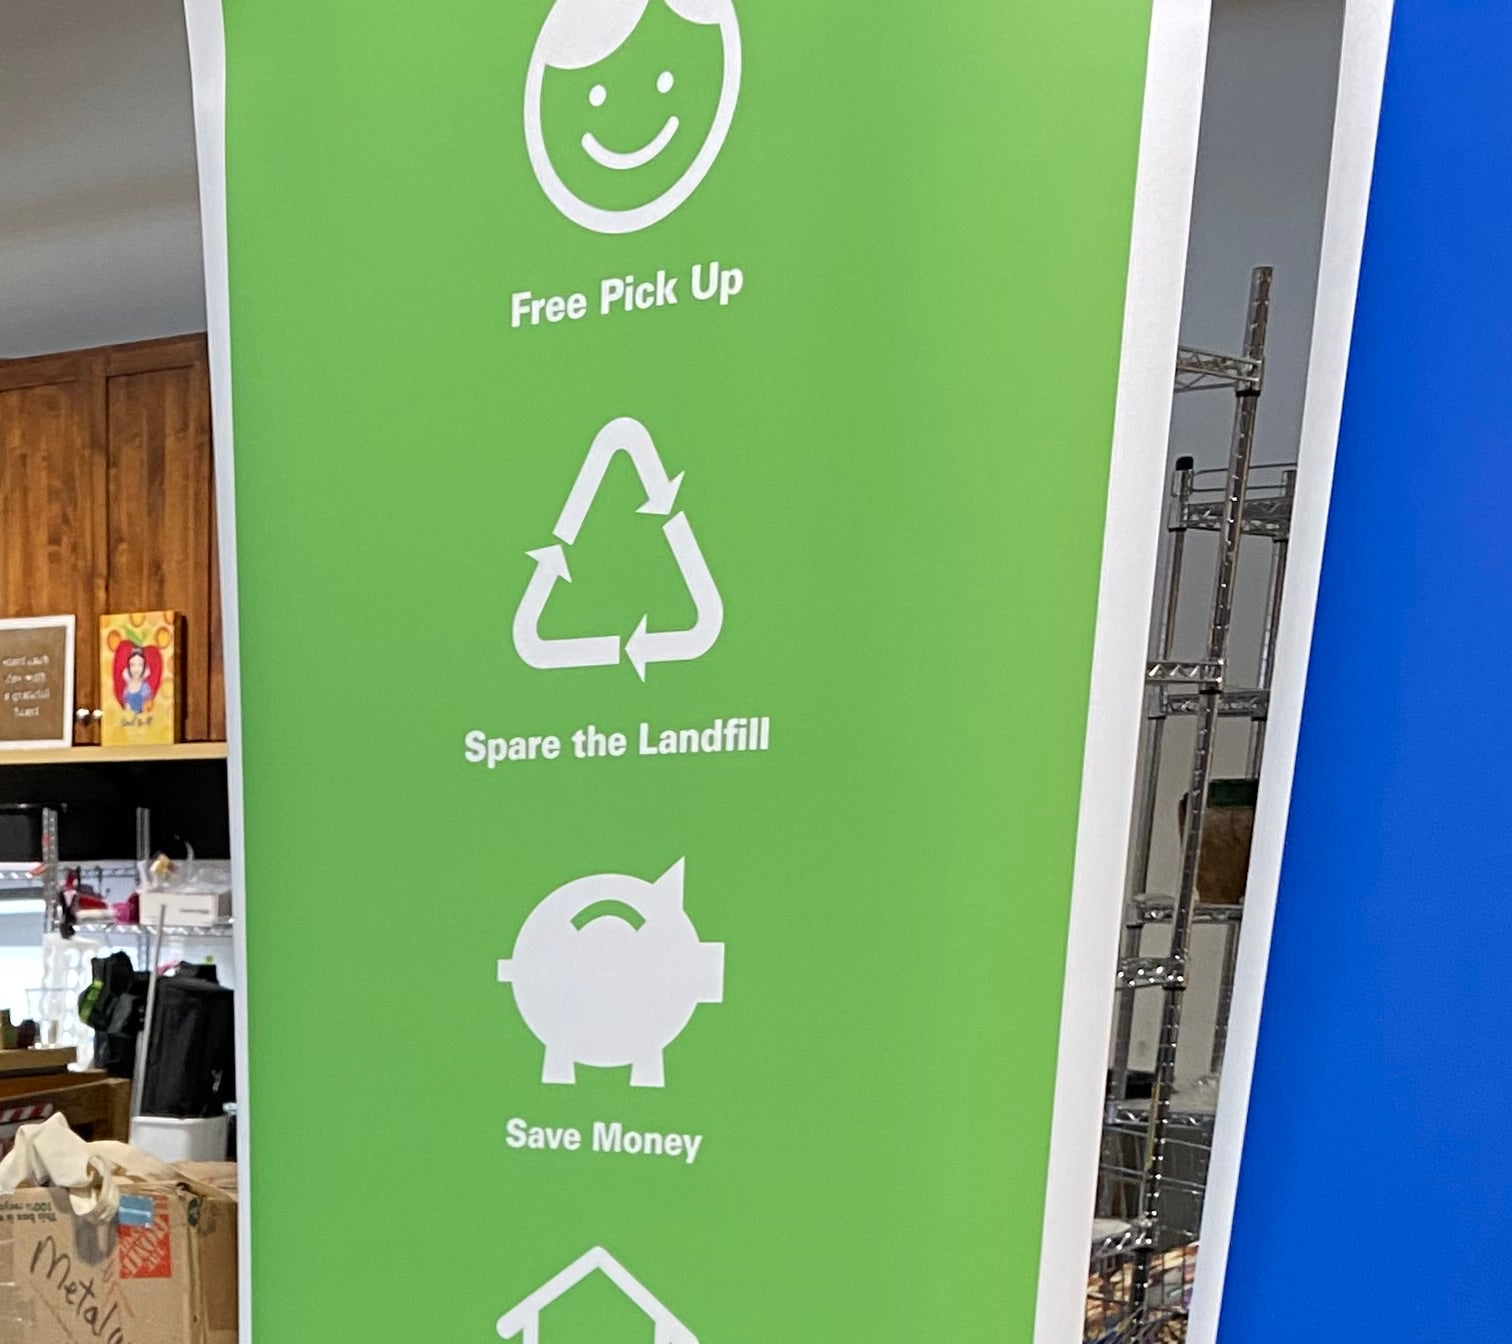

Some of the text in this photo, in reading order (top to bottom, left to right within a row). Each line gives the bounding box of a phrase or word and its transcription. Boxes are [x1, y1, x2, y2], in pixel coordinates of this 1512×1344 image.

[511, 261, 744, 328] Free Pick Up
[464, 716, 770, 769] Spare the Landfill
[506, 1117, 702, 1164] Save Money
